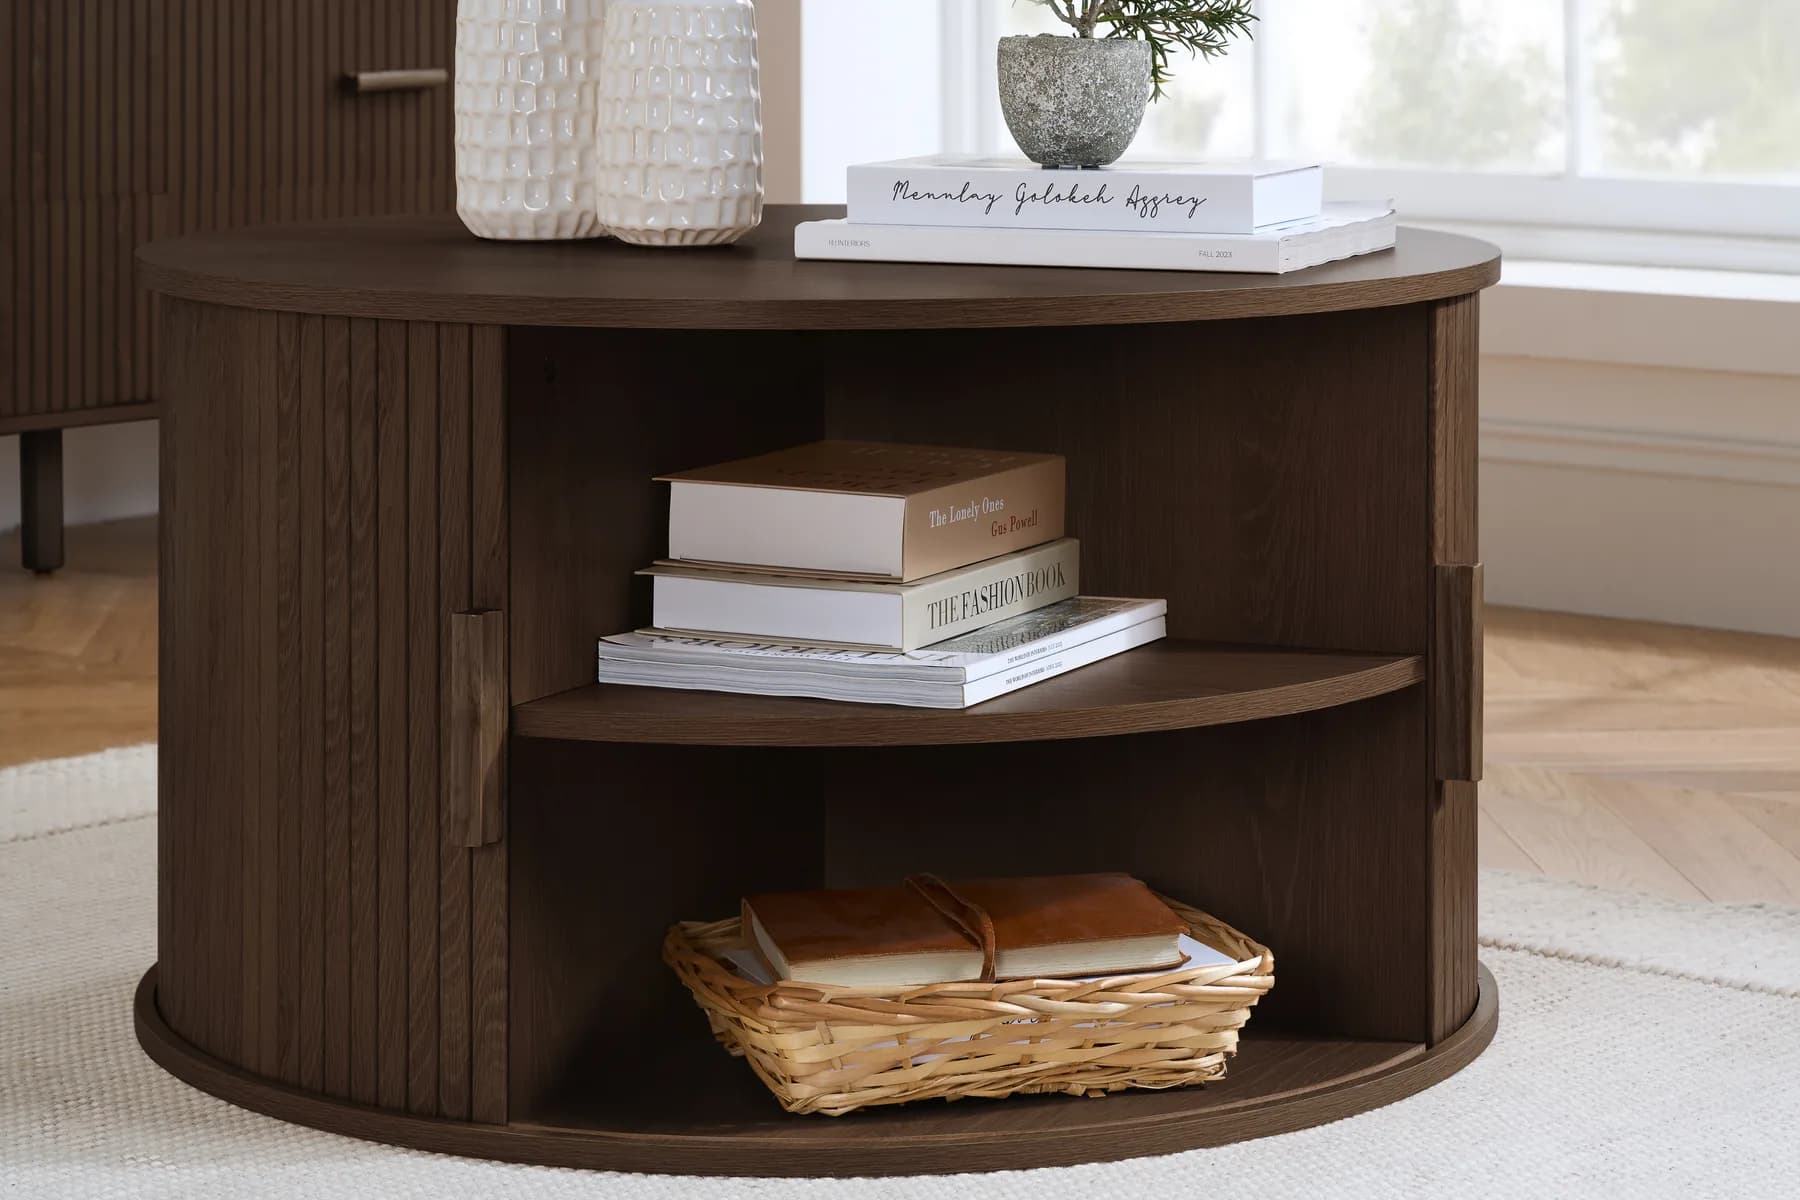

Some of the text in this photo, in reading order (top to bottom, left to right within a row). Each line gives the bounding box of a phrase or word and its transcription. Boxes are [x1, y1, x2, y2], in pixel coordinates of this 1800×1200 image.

[893, 180, 1207, 219] Mennlay Golokeh Aggrey
[1199, 249, 1233, 259] FALL 2023
[929, 496, 1004, 529] The Lonely Ones
[991, 509, 1038, 537] Gus Powell
